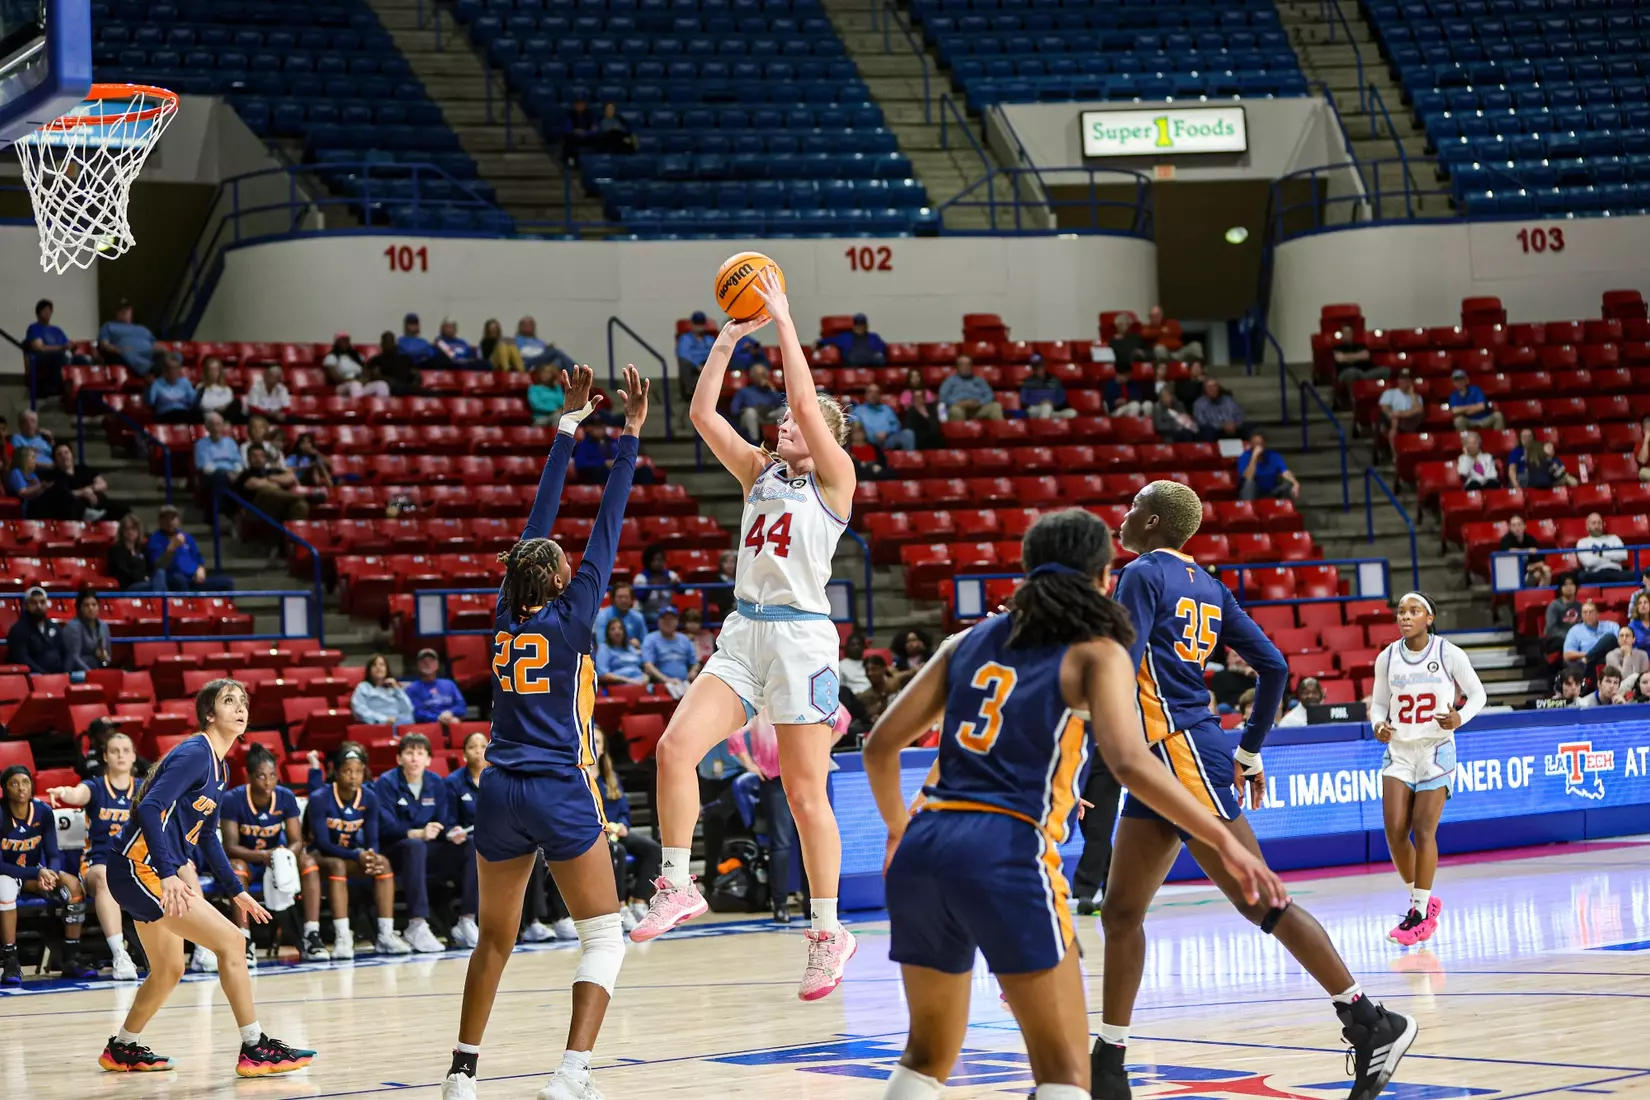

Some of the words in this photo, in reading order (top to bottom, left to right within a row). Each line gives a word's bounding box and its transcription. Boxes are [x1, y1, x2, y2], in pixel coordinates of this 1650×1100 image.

[1092, 122, 1152, 144] Super
[1154, 116, 1174, 147] 1
[1174, 118, 1236, 137] Foods
[1516, 227, 1565, 254] 103
[383, 244, 428, 273] 101
[845, 246, 893, 272] 102
[719, 263, 754, 299] Wilson
[745, 512, 793, 558] 44
[1174, 596, 1222, 670] 35
[492, 630, 550, 694] 22
[955, 660, 1018, 755] 3
[1398, 693, 1437, 724] 22
[1450, 758, 1503, 793] NER
[1507, 756, 1535, 789] OF
[1558, 741, 1615, 784] TECH
[1624, 747, 1650, 777] AT
[16, 853, 27, 868] 4
